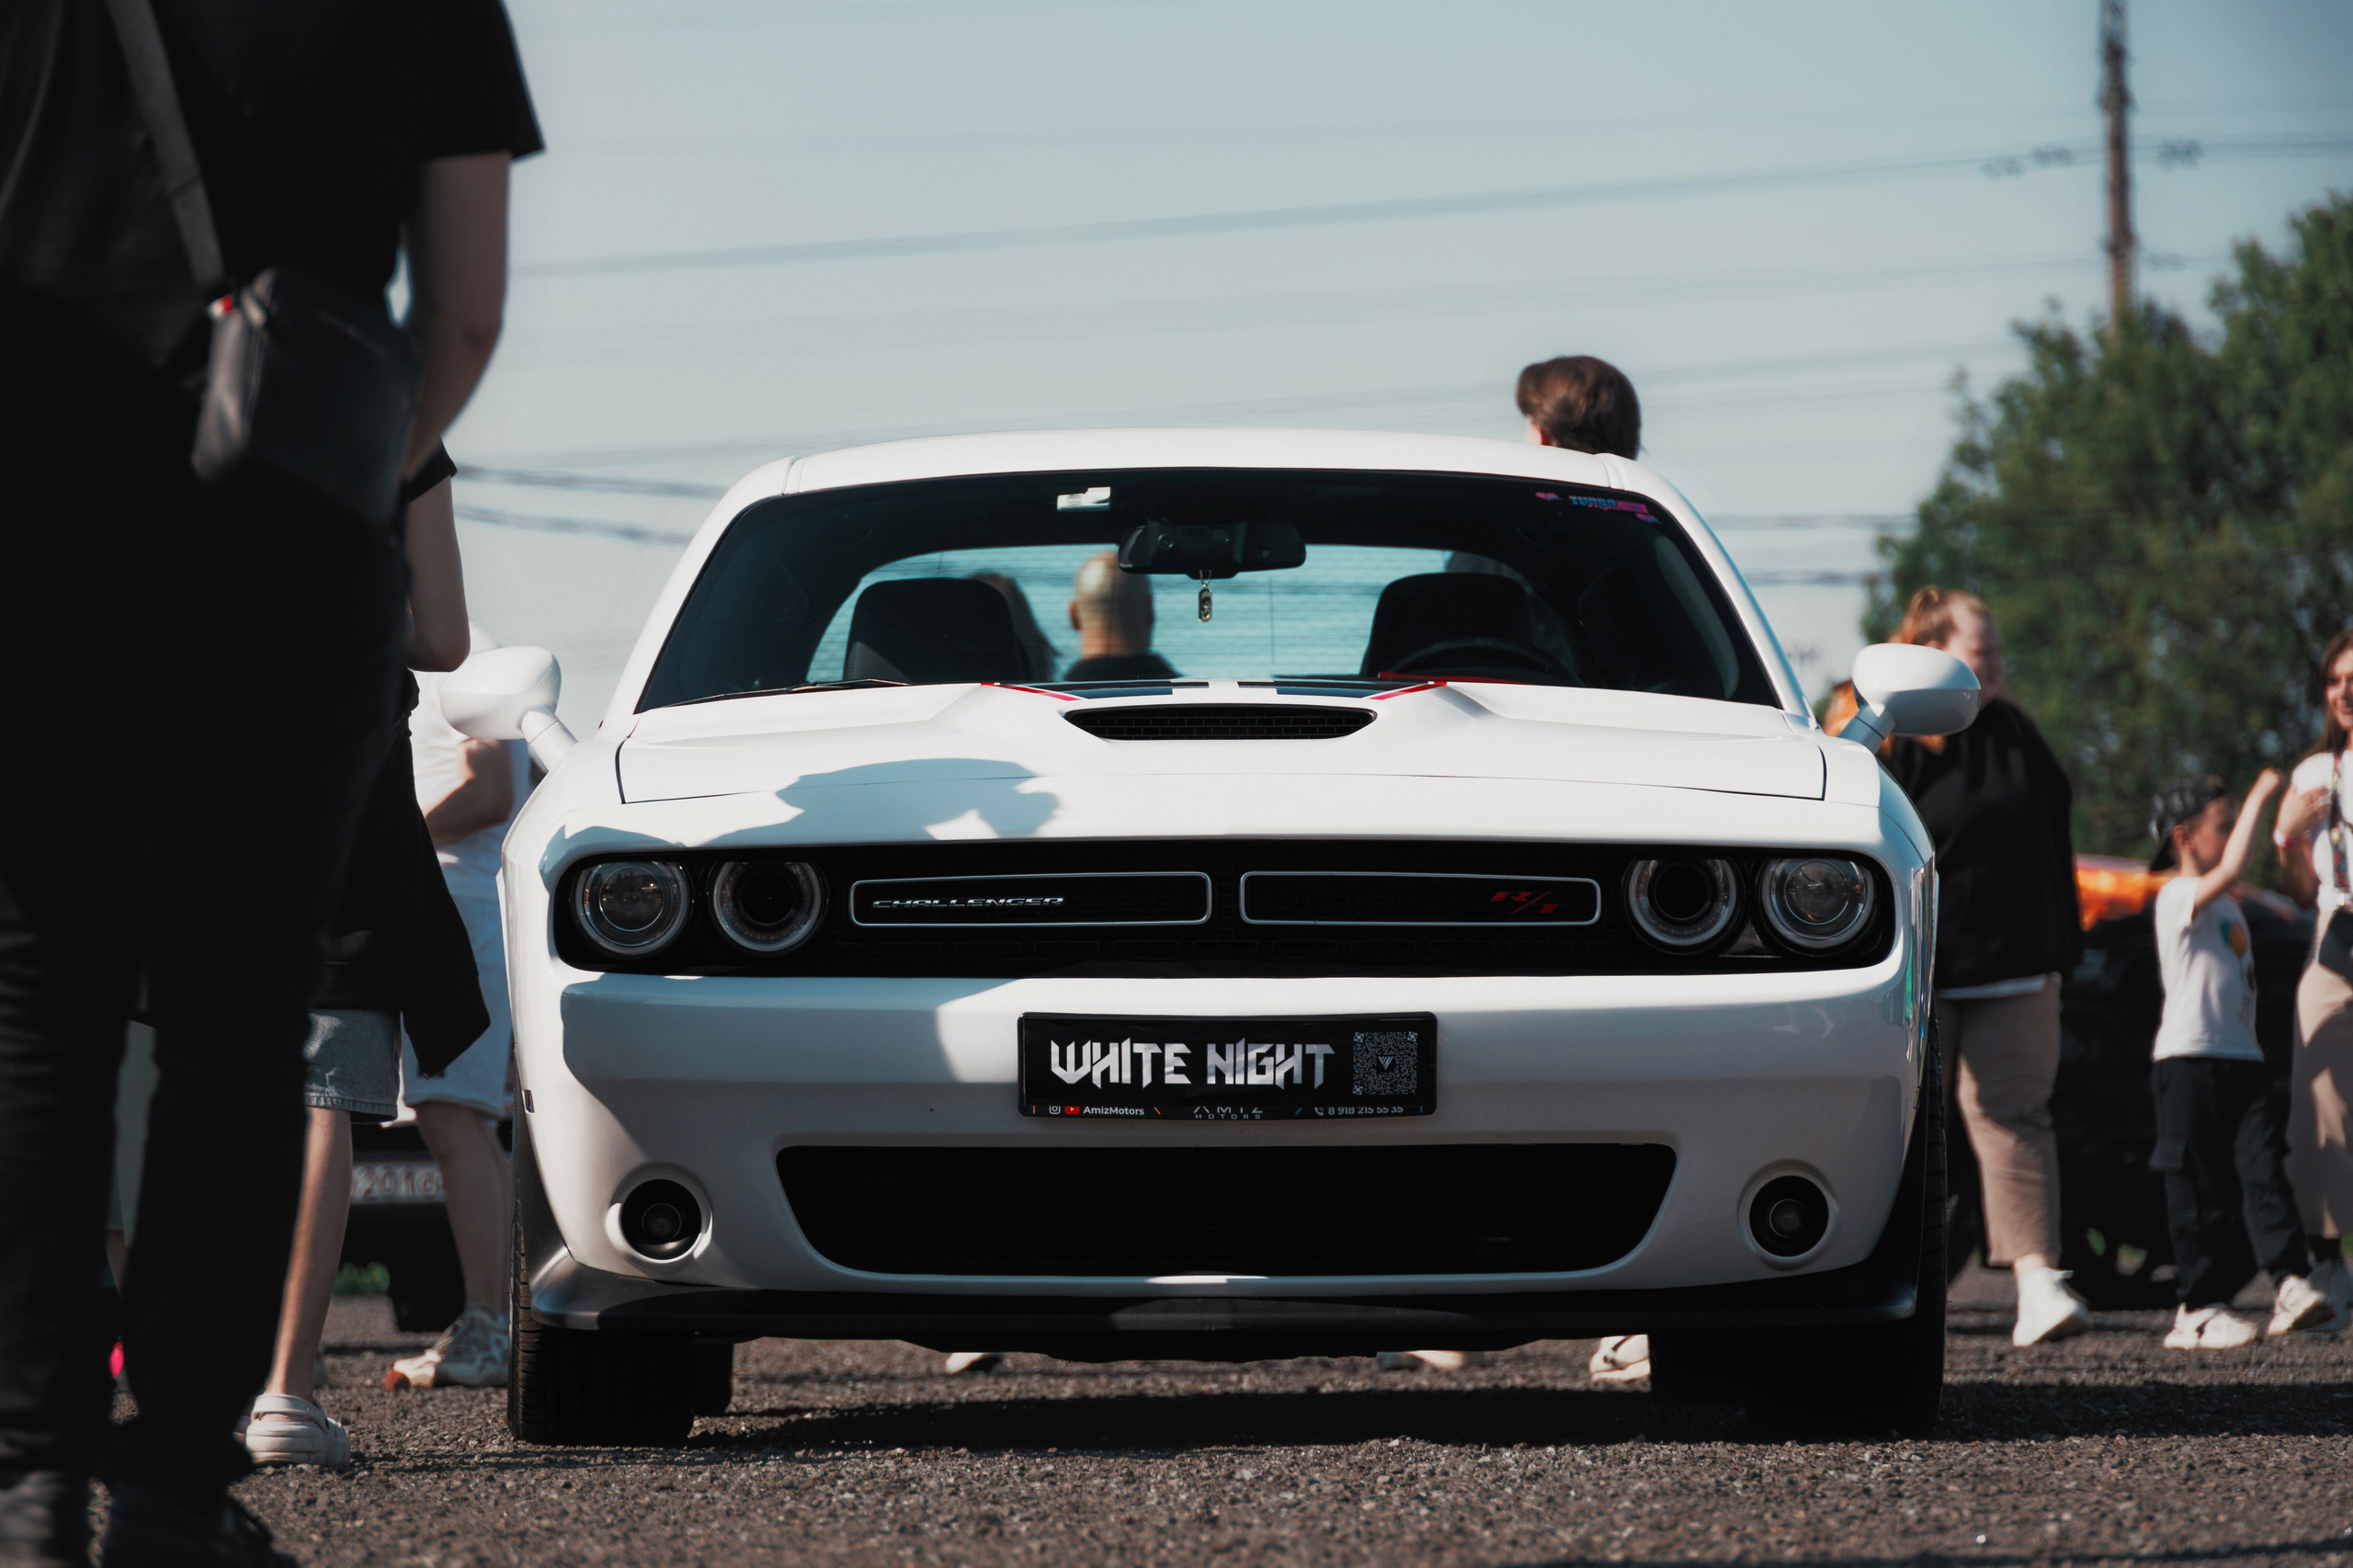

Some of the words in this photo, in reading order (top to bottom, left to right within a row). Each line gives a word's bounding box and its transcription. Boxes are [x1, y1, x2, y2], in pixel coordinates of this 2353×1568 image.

[872, 897, 1064, 908] CHALLENGER
[1491, 890, 1565, 915] R/T
[1051, 1038, 1192, 1089] WHITE
[1207, 1038, 1336, 1089] NIGHT
[1083, 1106, 1145, 1116] AmizMotors
[1328, 1107, 1336, 1115] 8
[1337, 1107, 1356, 1115] 918
[1358, 1106, 1375, 1114] 215
